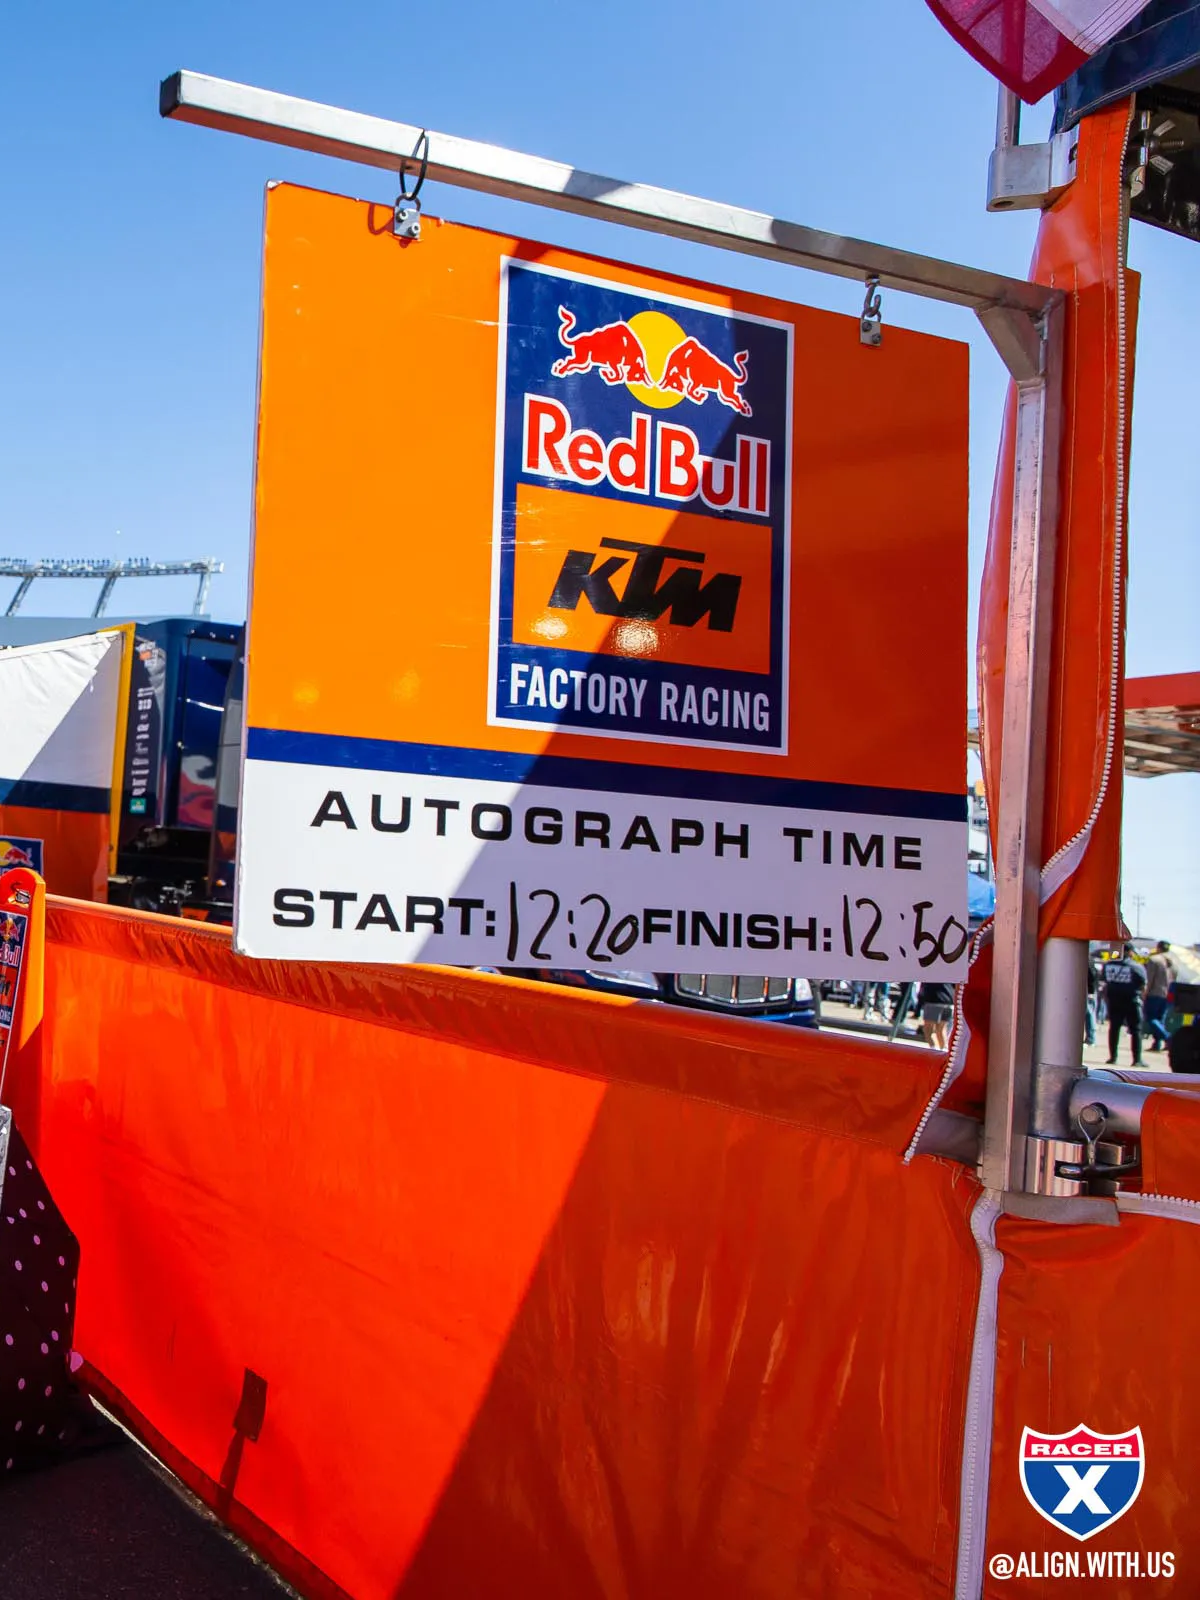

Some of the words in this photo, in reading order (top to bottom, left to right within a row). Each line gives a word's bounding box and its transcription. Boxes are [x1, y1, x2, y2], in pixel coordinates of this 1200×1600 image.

[521, 392, 651, 494] Red
[655, 421, 772, 517] Bull
[548, 537, 742, 633] KTM
[509, 662, 648, 718] FACTORY
[659, 681, 770, 732] RACING
[310, 790, 749, 858] AUTOGRAPH
[783, 827, 922, 870] TIME
[272, 887, 496, 936] START:
[507, 881, 639, 962] 12:20
[642, 907, 832, 952] FINISH:
[843, 894, 968, 967] 12:50
